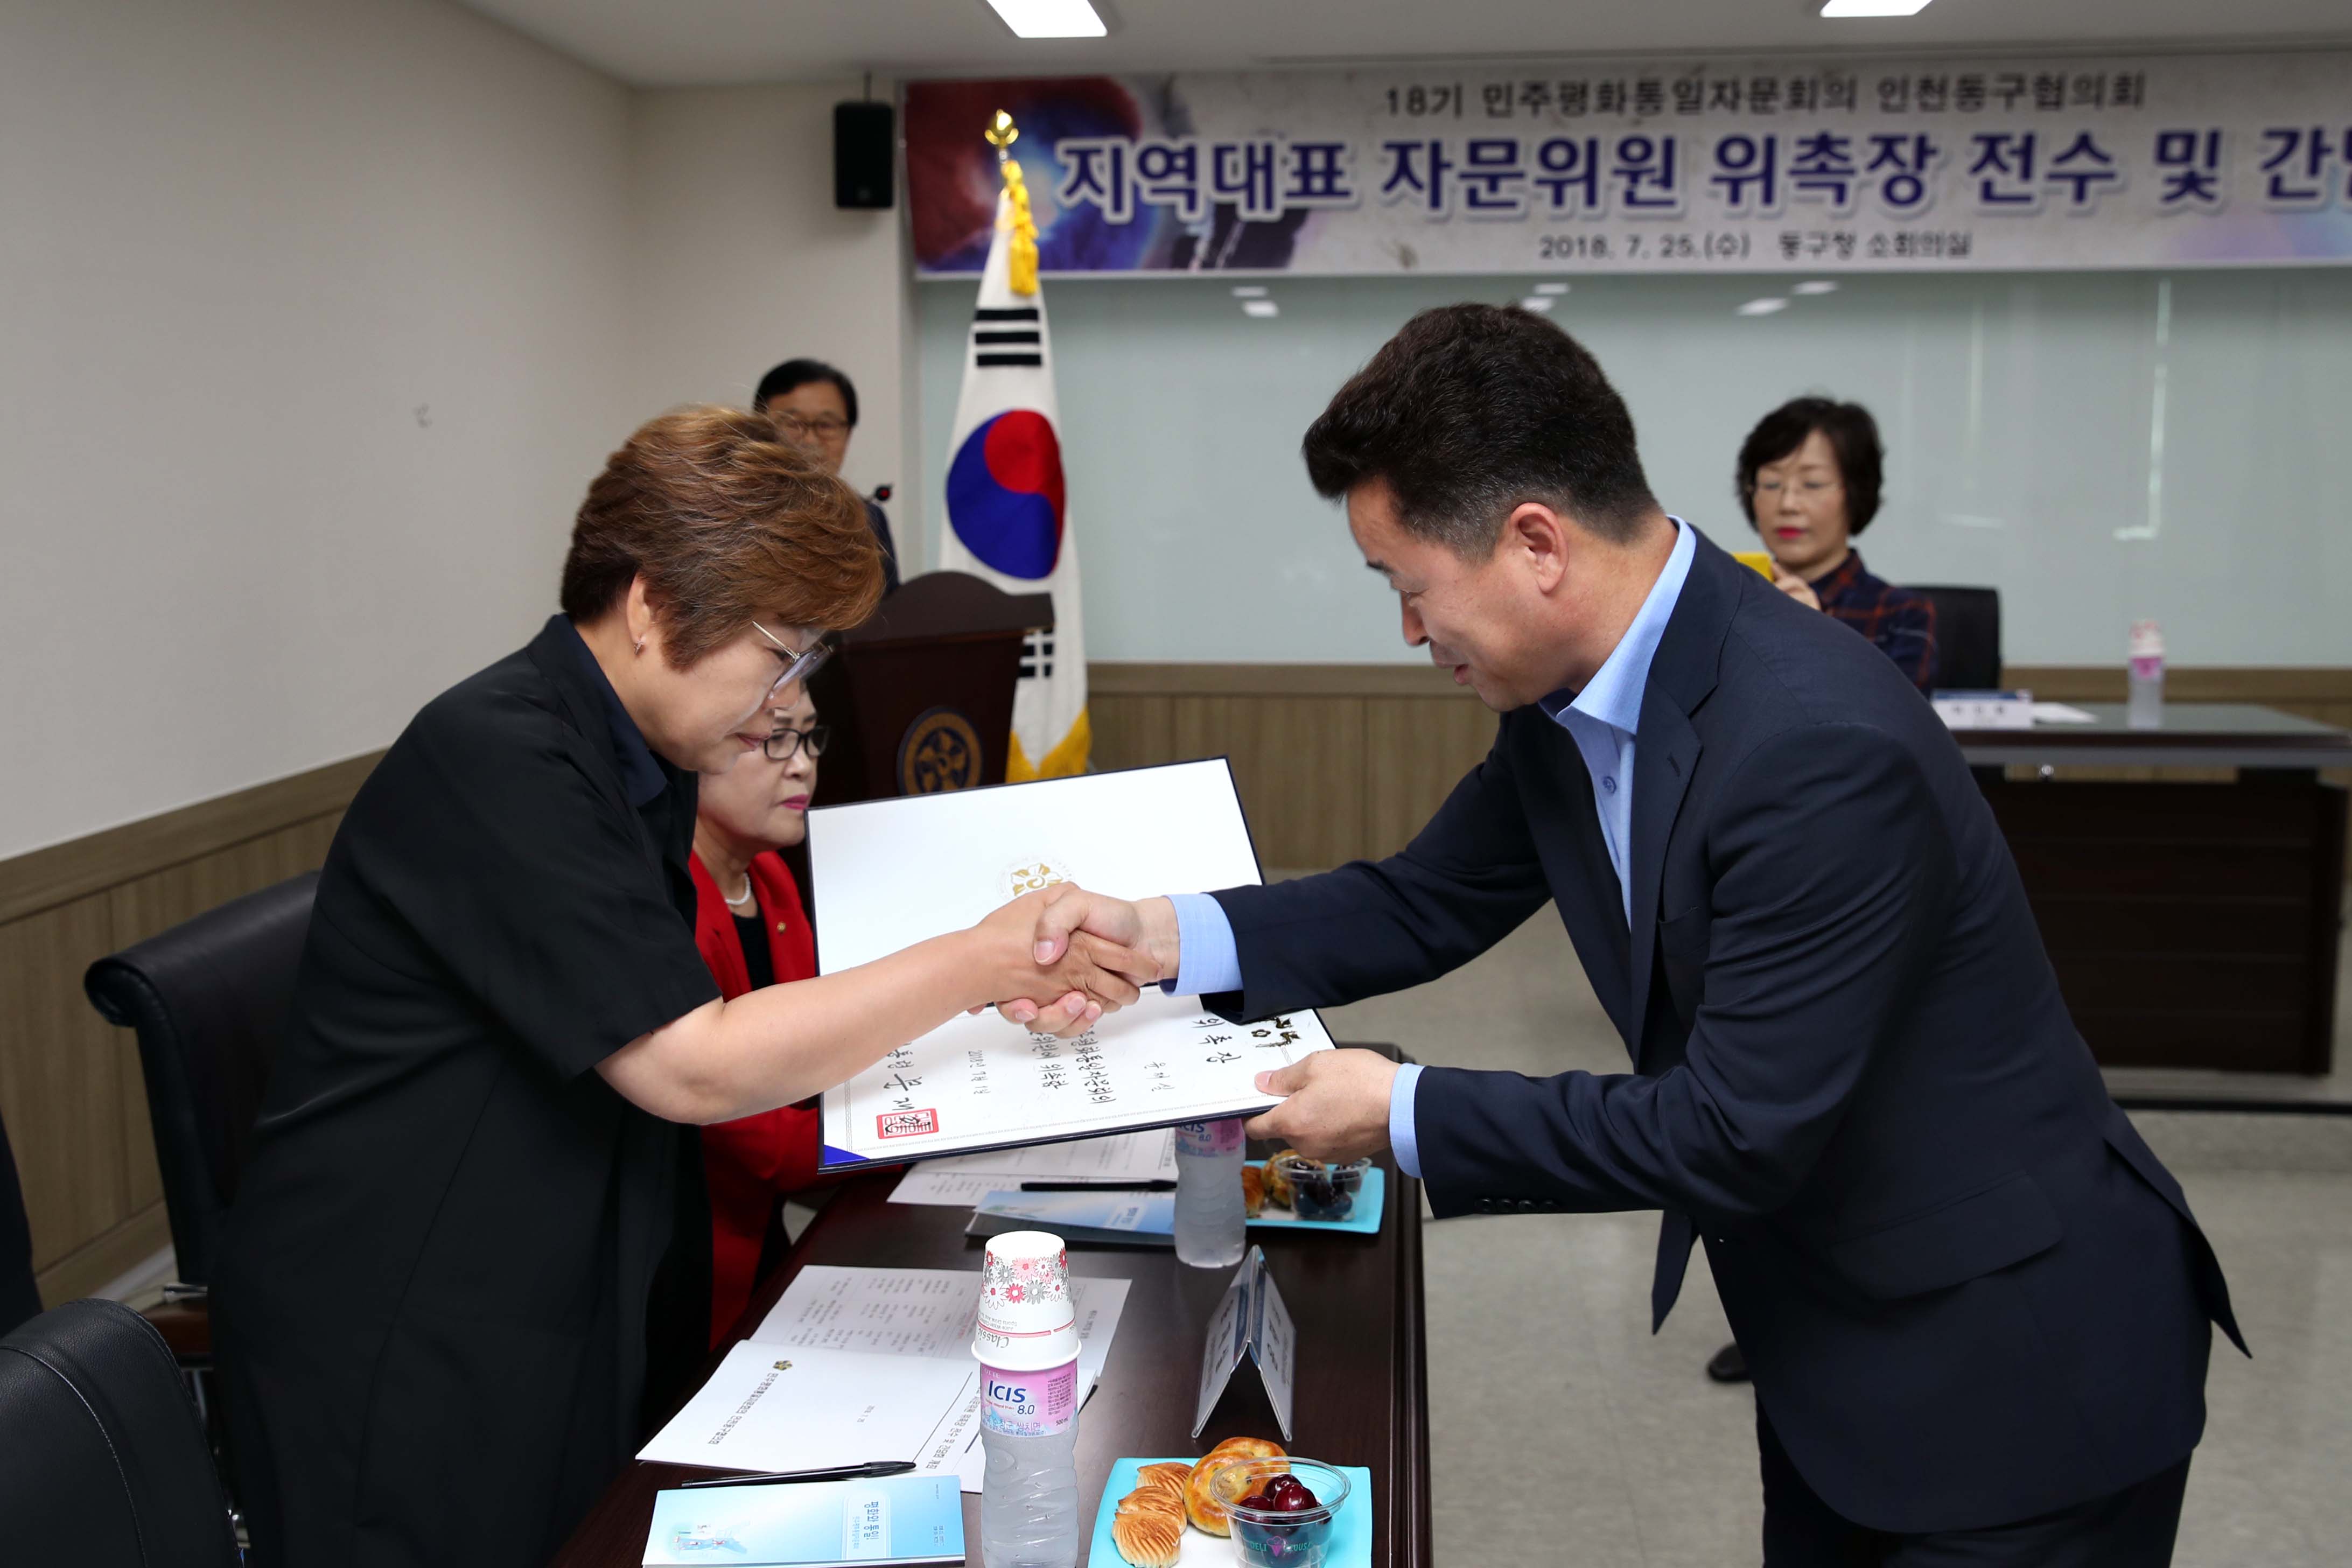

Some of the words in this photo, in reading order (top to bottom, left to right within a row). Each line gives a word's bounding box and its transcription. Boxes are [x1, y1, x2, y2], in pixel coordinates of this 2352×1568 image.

[1387, 82, 1463, 118] 18기
[1482, 76, 1856, 118] 민주평화통일자문회의
[1877, 70, 2145, 113] 인천동구협의회
[1063, 143, 1352, 214] 지역대표
[1382, 136, 1677, 210] 자문위원
[1710, 131, 1938, 206] 위촉장
[1969, 131, 2116, 204] 전수
[2155, 129, 2222, 203] 및
[2260, 127, 2352, 200] 간
[1538, 233, 1615, 260] 2018.
[1626, 233, 1651, 260] 7.
[1779, 230, 1856, 261] 동구청
[1866, 230, 1971, 260] 소회의실
[887, 1042, 915, 1069] 통령
[1071, 1025, 1116, 1104] 주평화통일자문회의
[978, 1328, 1009, 1348] Classic
[989, 1381, 1026, 1403] ICIS
[1017, 1404, 1035, 1415] 8.0
[1017, 1421, 1041, 1432] 쌍치면
